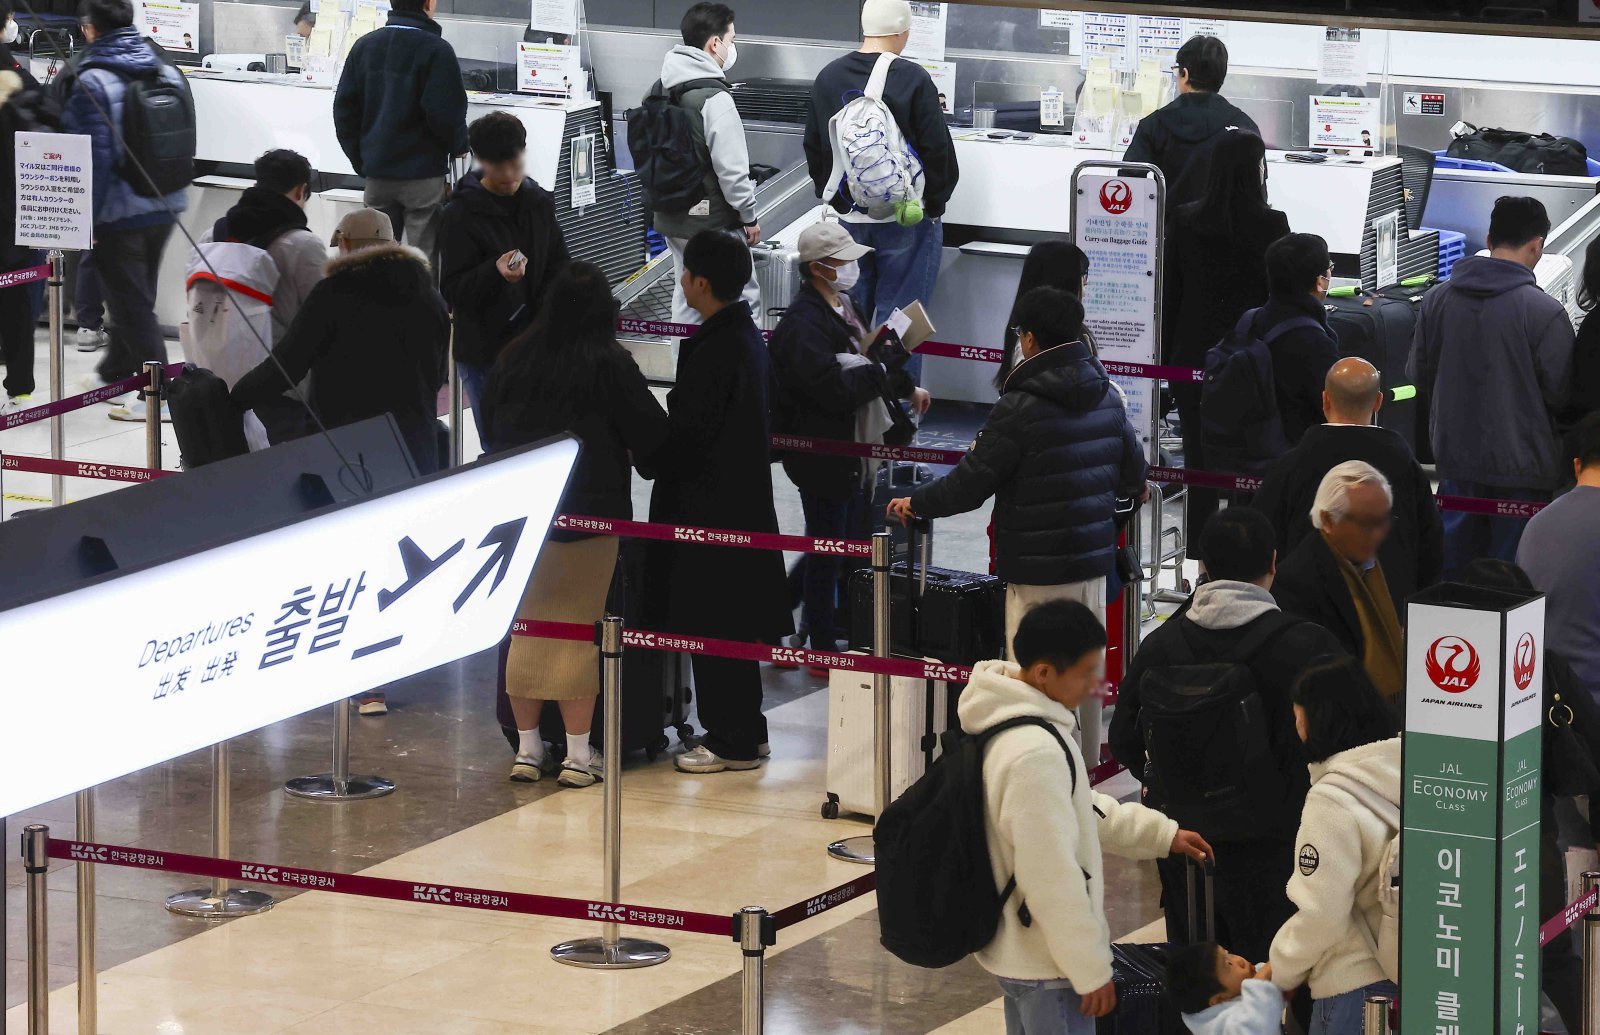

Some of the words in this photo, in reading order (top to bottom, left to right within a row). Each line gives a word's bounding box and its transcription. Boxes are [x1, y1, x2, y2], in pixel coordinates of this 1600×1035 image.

[1110, 237, 1131, 245] Baggage
[621, 320, 647, 332] KAC
[650, 324, 687, 334] 한국공항공사
[961, 347, 987, 359] KAC
[7, 412, 24, 427] KAC
[25, 408, 50, 420] 한국공항공사
[772, 437, 812, 448] 한국공항공사
[872, 446, 900, 458] KAC
[903, 451, 944, 461] 한국공항공사
[78, 464, 106, 478] KAC
[110, 469, 150, 480] 한국공항공사
[1497, 502, 1529, 515] KAC
[569, 518, 612, 530] 한국공항공사
[674, 528, 704, 541] KAC
[707, 532, 750, 544] 한국공항공사
[814, 540, 844, 552] KAC
[258, 571, 366, 670] 출발
[138, 612, 255, 669] Departures
[622, 631, 654, 646] KAC
[658, 637, 704, 650] 한국공항공사
[772, 648, 804, 663] KAC
[807, 654, 854, 666] 한국공항공사
[924, 664, 957, 680] KAC
[1519, 672, 1531, 685] JAL
[1440, 676, 1469, 687] JAL
[1447, 700, 1482, 709] AIRLINES
[1511, 699, 1521, 708] JAPAN
[1521, 693, 1536, 704] AIRLINES
[1440, 763, 1462, 775] JAL
[1517, 760, 1527, 772] JAL
[1413, 780, 1488, 802] ECONOMY
[1436, 800, 1466, 812] CLASS
[71, 844, 107, 861] KAC
[111, 850, 164, 865] 한국공항공사
[241, 864, 278, 882] KAC
[282, 872, 336, 888] 한국공항공사
[413, 885, 450, 902] KAC
[454, 892, 508, 906] 한국공항공사
[807, 895, 826, 916] KAC
[827, 886, 855, 904] 한국공항공사
[588, 903, 626, 921] KAC
[629, 911, 684, 926] 한국공항공사
[1436, 848, 1462, 977] 이코노미
